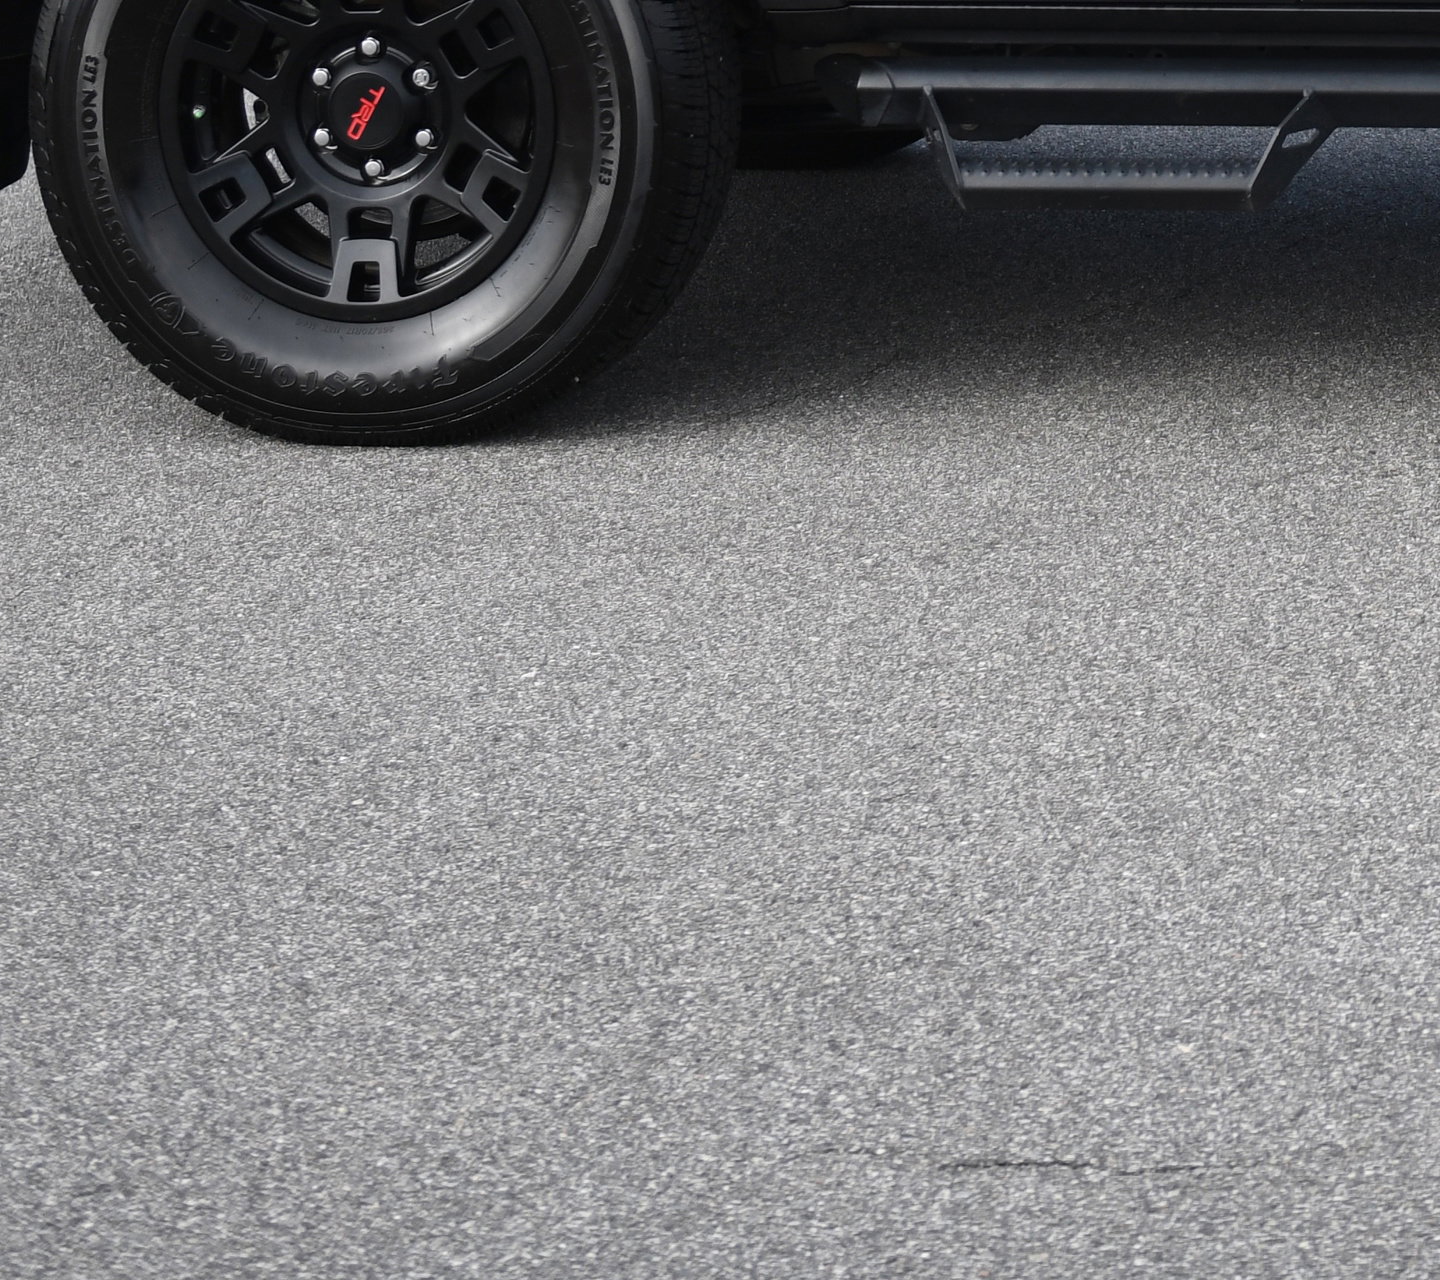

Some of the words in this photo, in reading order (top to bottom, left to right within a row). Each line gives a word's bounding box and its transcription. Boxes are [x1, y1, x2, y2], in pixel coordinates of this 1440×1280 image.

[82, 54, 100, 85] LE3
[346, 85, 386, 141] TRD
[80, 90, 142, 265] DESTINATION
[598, 160, 615, 187] LE3
[210, 335, 460, 397] Firestone
